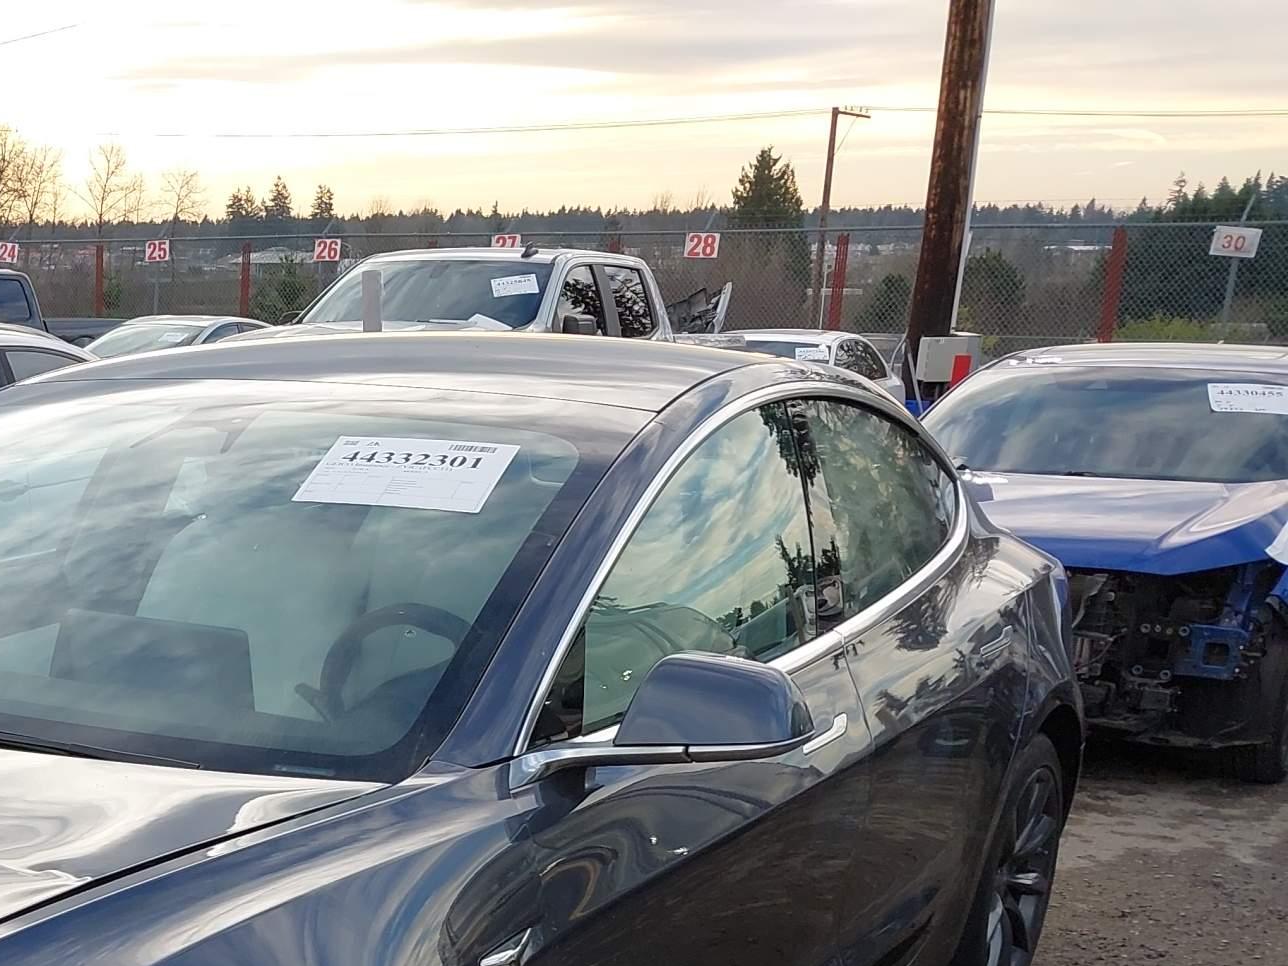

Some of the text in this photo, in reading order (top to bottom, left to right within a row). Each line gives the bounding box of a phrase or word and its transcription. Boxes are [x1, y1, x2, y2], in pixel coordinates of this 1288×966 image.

[147, 241, 168, 261] 25
[315, 240, 339, 260] 26
[495, 235, 518, 248] 27
[688, 234, 716, 257] 28
[1221, 235, 1246, 251] 30
[342, 450, 484, 469] 44332301
